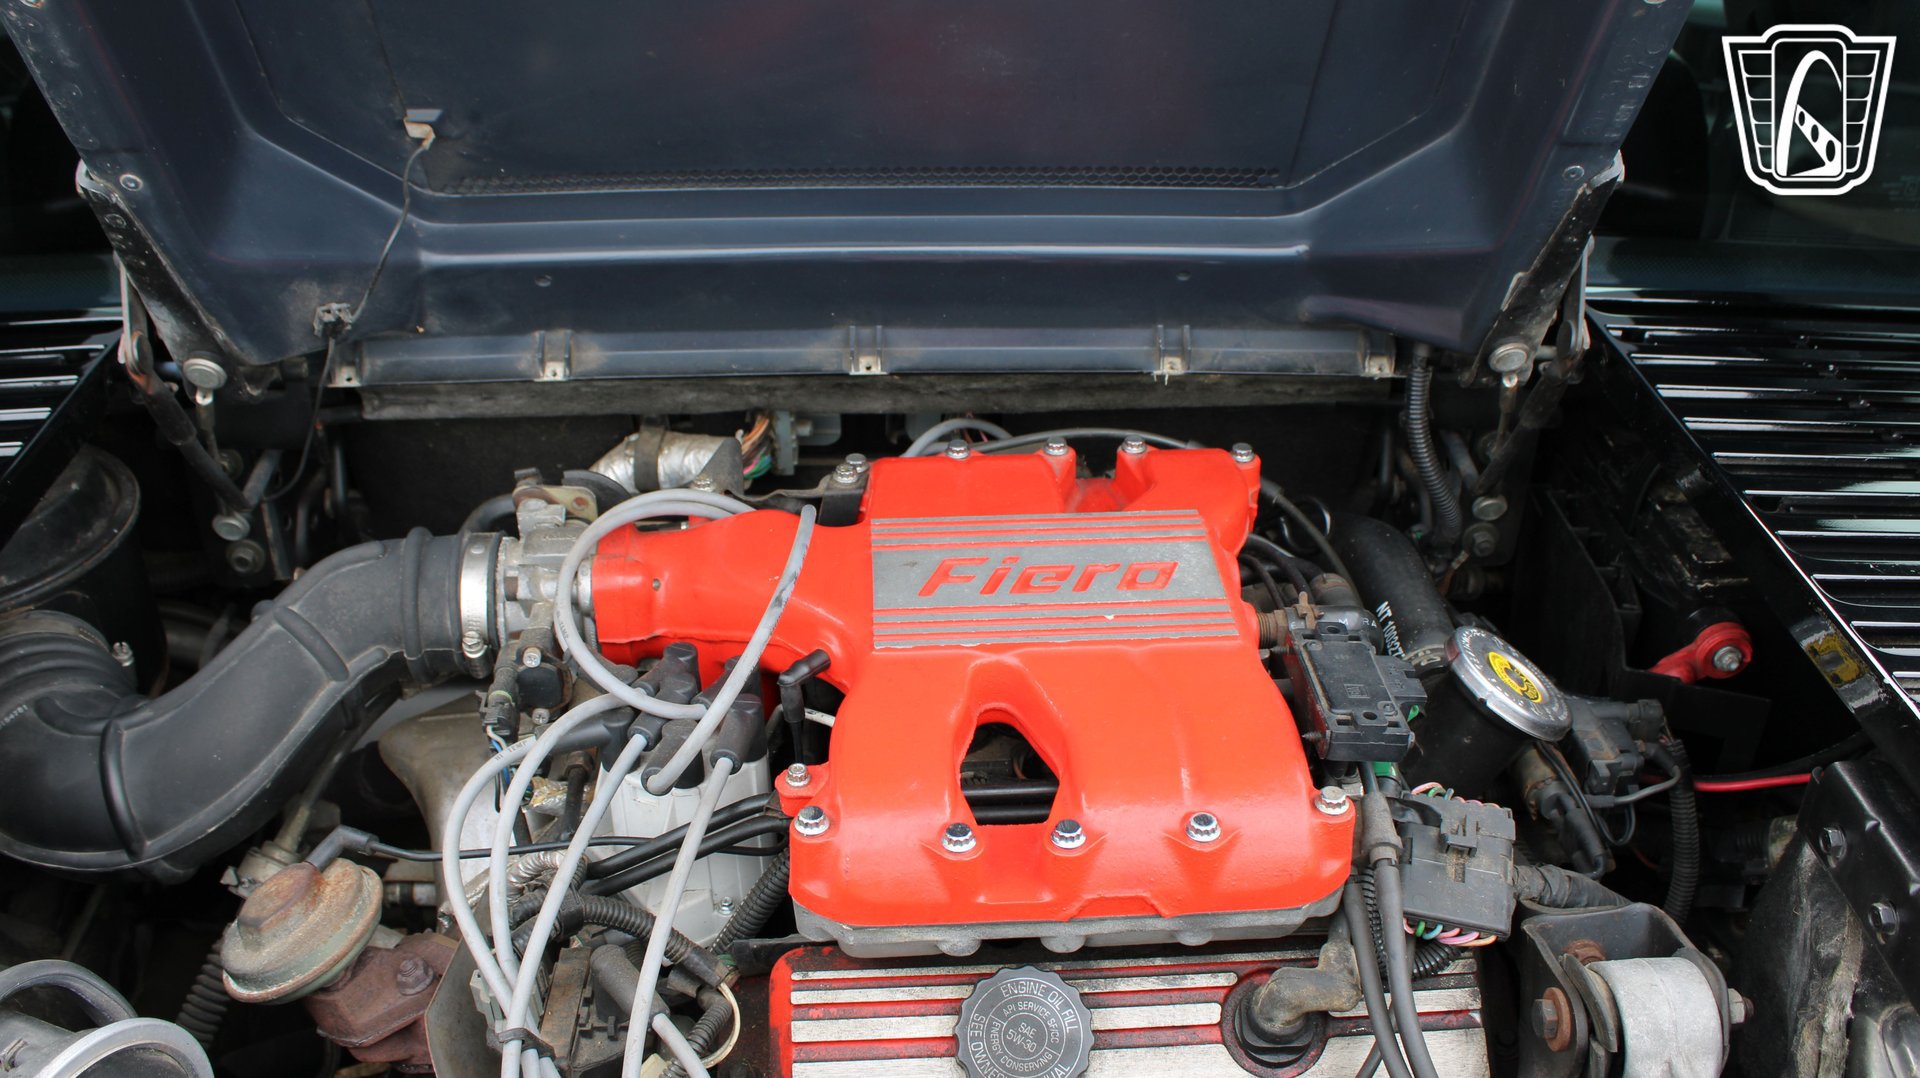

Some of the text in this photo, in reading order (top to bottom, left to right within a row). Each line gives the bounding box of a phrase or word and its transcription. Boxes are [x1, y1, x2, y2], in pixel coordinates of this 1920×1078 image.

[918, 556, 1179, 597] Fiero
[1376, 601, 1393, 624] NT
[1000, 981, 1079, 1034] ENGINE OIL FILL
[1002, 1000, 1060, 1044] API SERVICE SF/CC
[970, 1013, 986, 1037] SEE
[1006, 1029, 1037, 1053] 5W-30
[1018, 1022, 1037, 1039] SAE
[990, 1021, 1053, 1072] ENERGY CONSERVING
